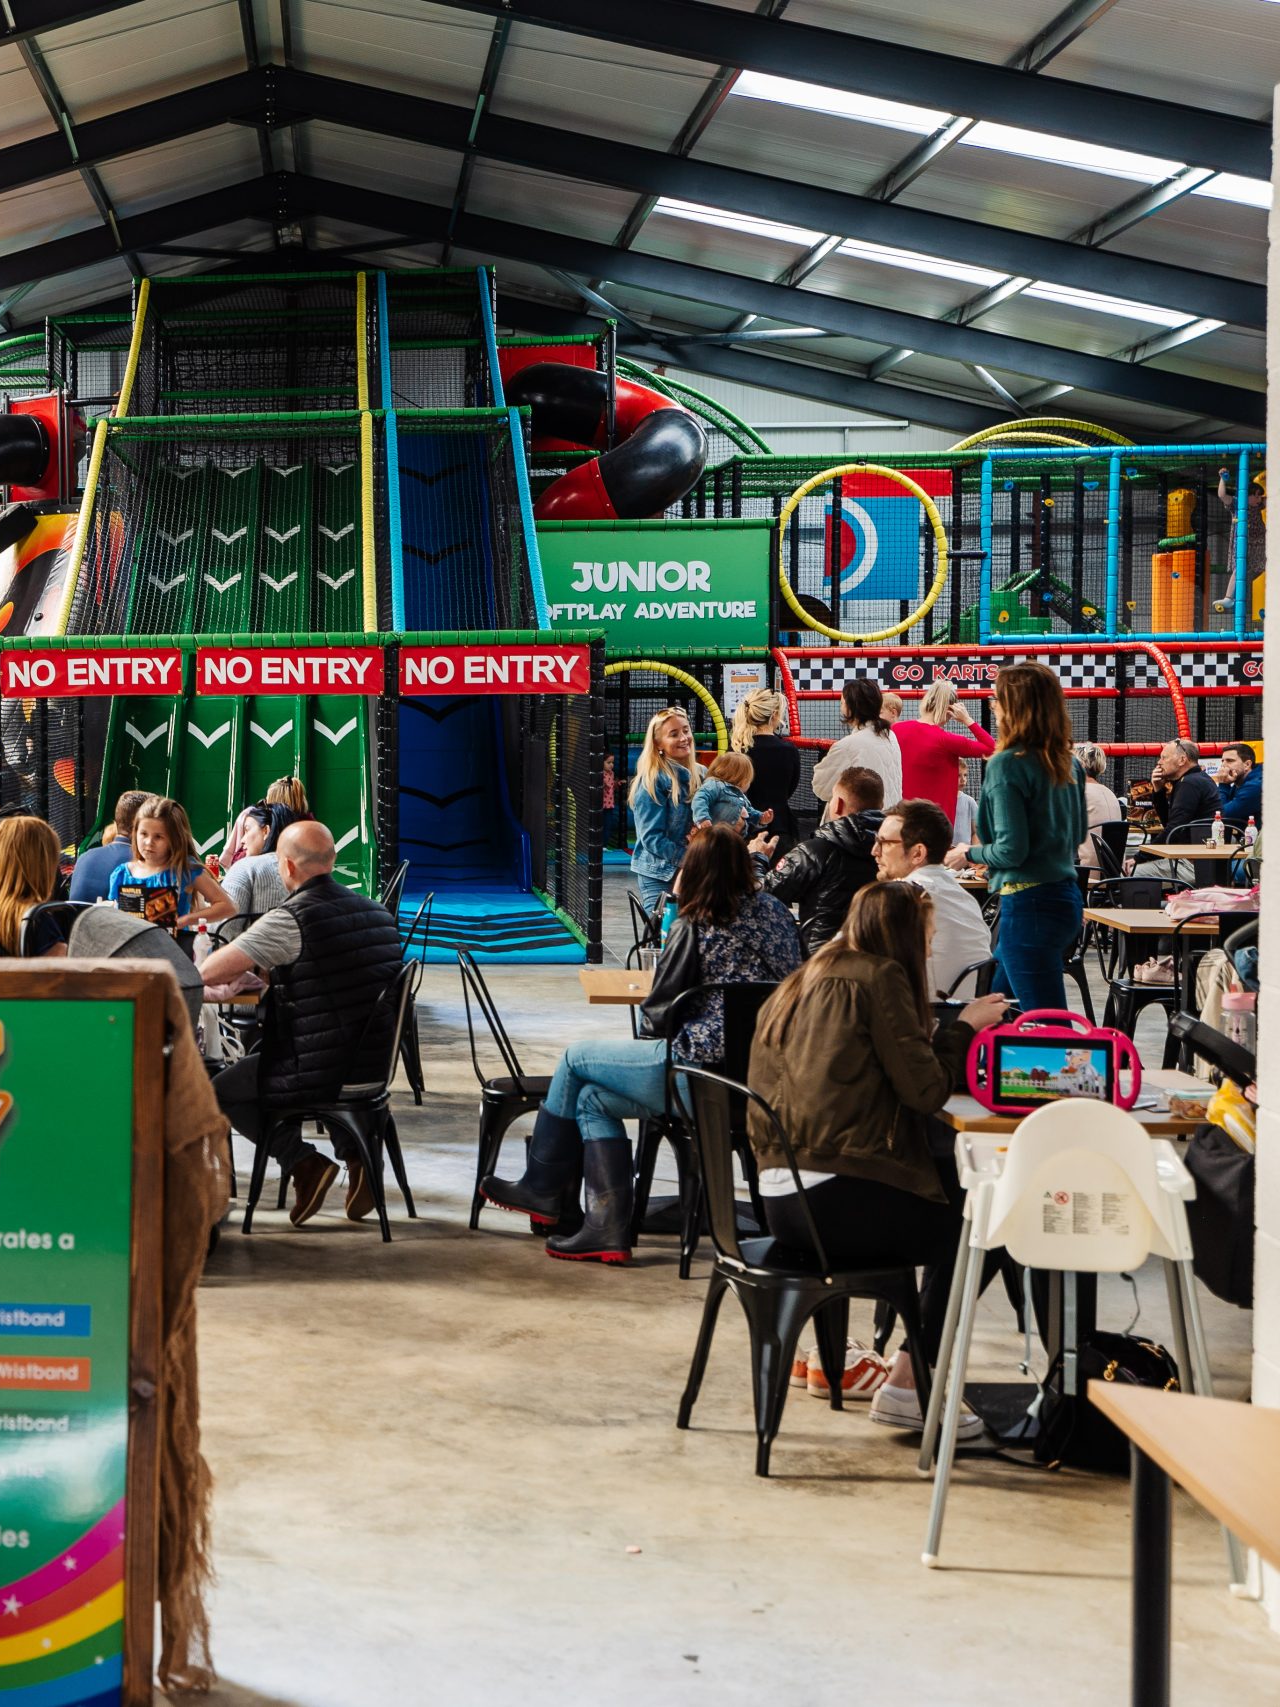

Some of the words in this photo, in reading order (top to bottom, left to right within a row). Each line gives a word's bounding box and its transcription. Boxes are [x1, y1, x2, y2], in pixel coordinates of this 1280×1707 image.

[570, 560, 711, 593] JUNIOR
[545, 603, 626, 621] FTPLAY
[633, 600, 757, 620] ADVENTURE
[8, 658, 57, 688] NO
[67, 656, 177, 686] ENTRY
[204, 656, 253, 686] NO
[261, 656, 373, 686] ENTRY
[405, 656, 455, 686] NO
[464, 655, 580, 684] ENTRY
[891, 664, 925, 682] GO
[932, 663, 1000, 681] KARTS
[57, 1232, 76, 1250] a
